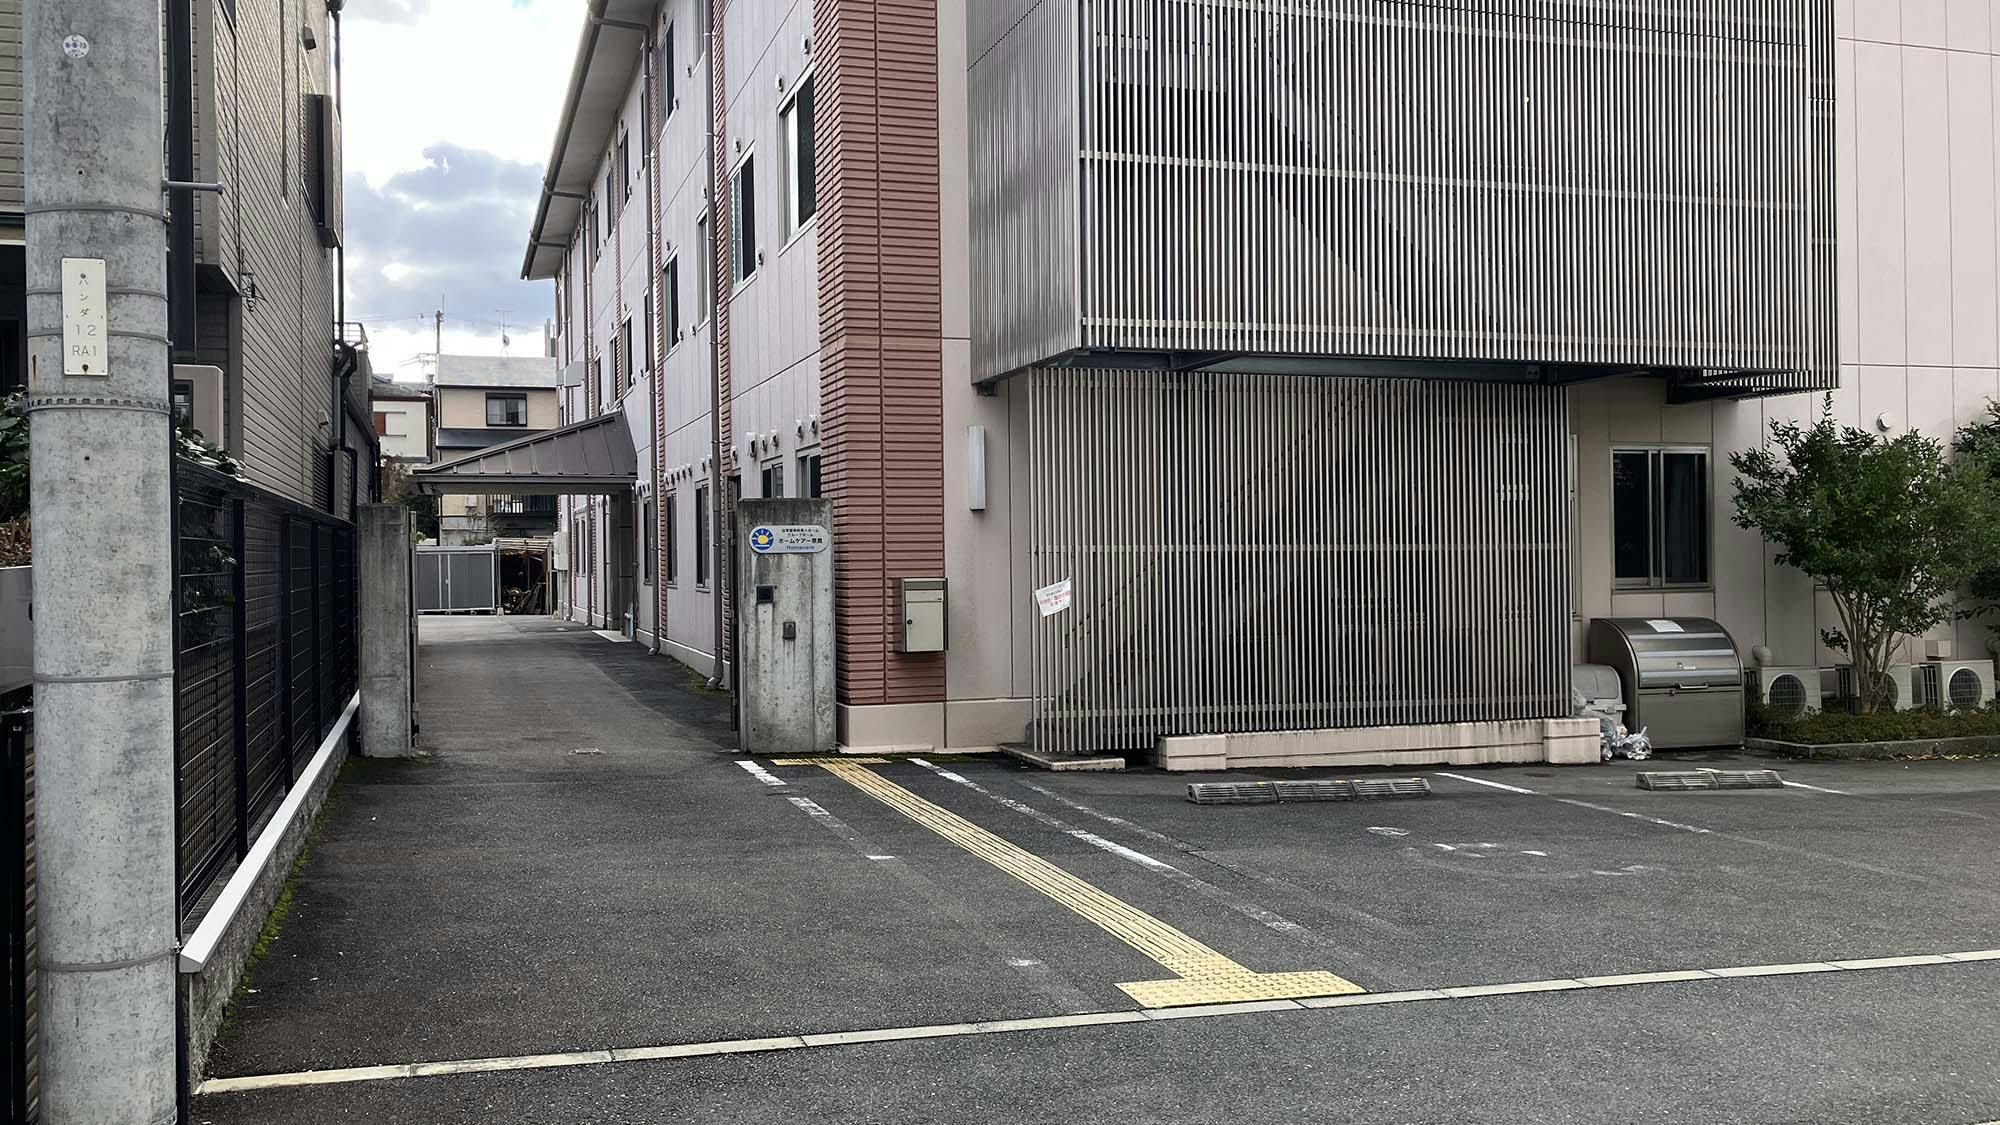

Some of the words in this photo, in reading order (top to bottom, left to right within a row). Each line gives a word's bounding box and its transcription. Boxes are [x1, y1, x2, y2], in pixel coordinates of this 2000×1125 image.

[78, 279, 90, 317] ハンダ
[72, 345, 97, 356] RA1
